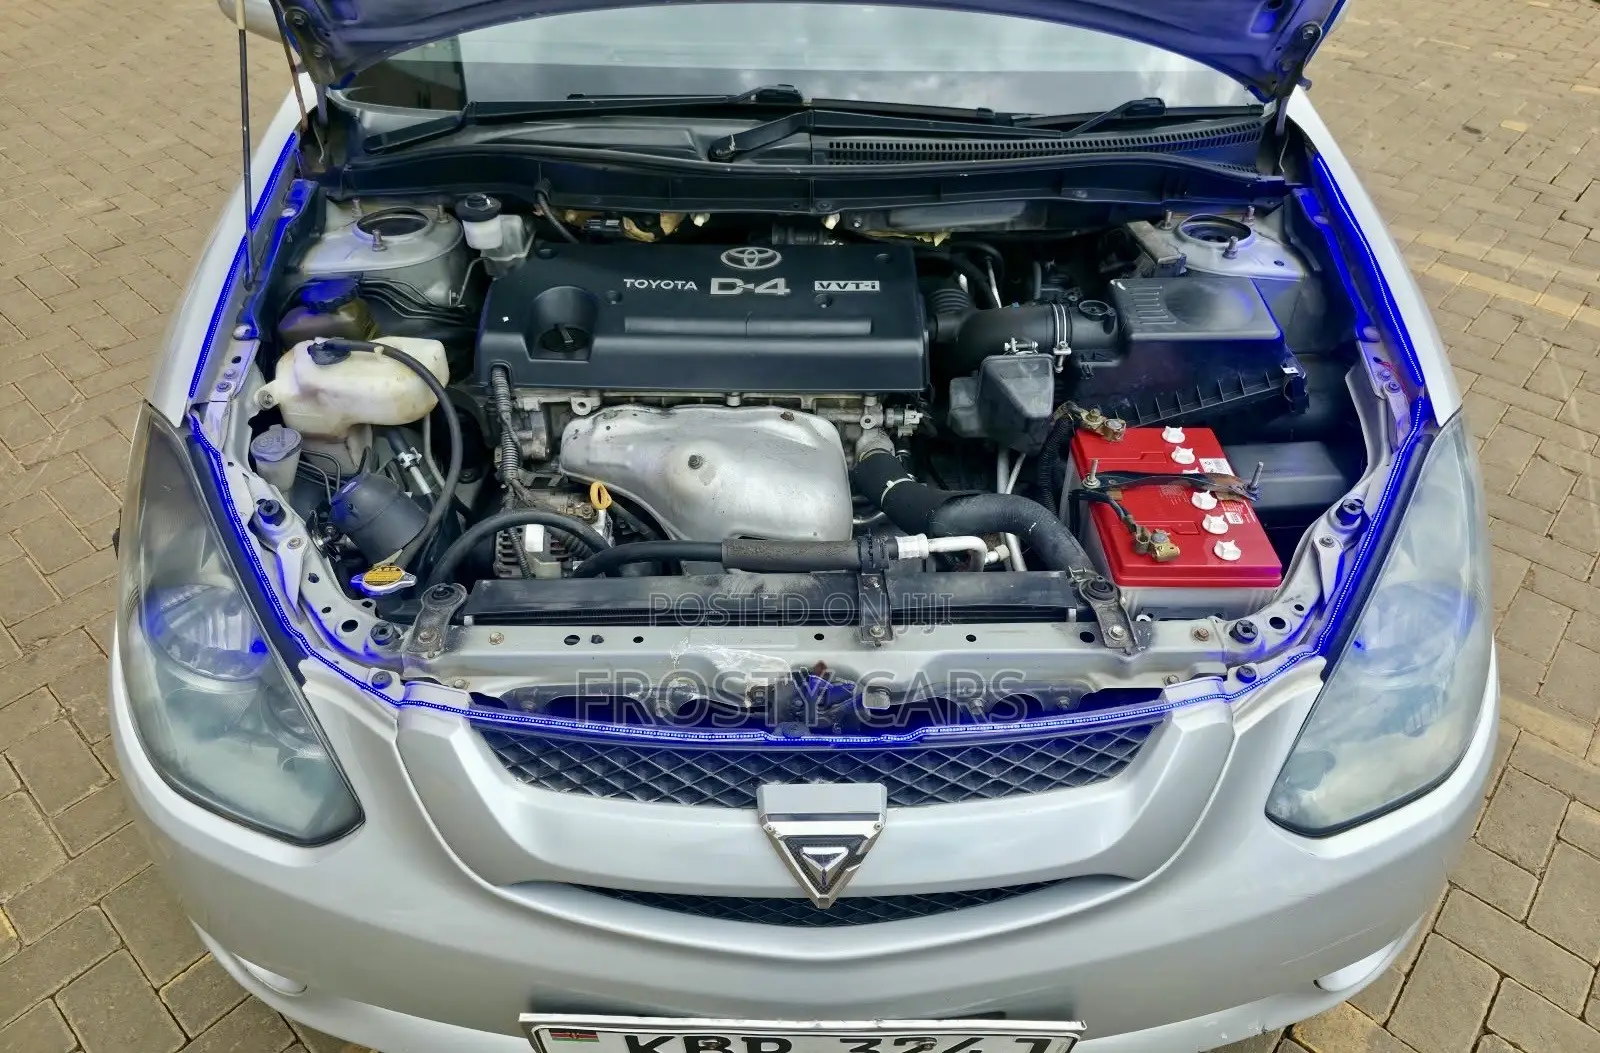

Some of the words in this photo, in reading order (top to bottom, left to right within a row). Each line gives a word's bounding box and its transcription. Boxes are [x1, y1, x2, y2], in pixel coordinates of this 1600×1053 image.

[623, 278, 698, 290] TOYOTA
[710, 277, 791, 295] D-4
[815, 281, 879, 291] VVT-i
